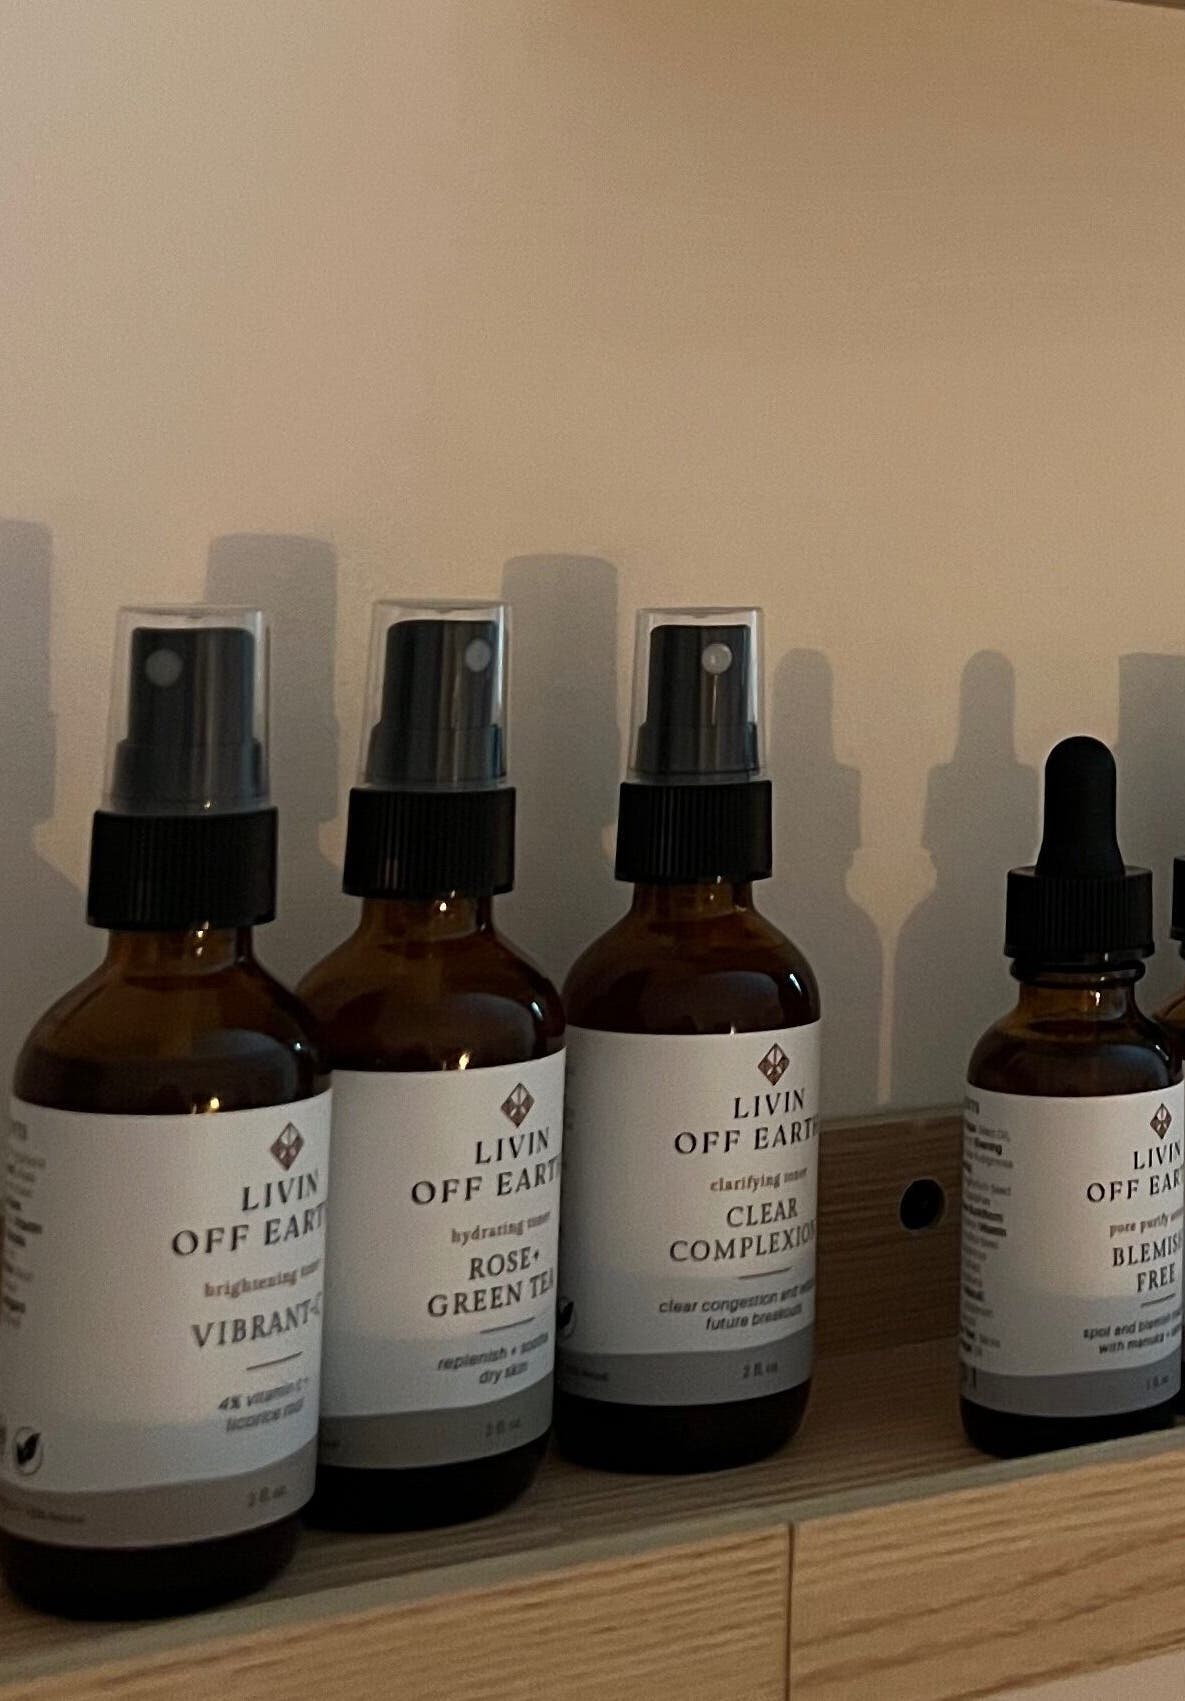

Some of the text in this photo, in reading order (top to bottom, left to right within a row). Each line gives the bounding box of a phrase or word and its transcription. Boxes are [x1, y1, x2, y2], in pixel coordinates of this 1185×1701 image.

[733, 1088, 805, 1119] LIVIN
[475, 1126, 550, 1165] LIVIN
[674, 1129, 741, 1154] OFF
[242, 1168, 319, 1212] LIVIN
[411, 1153, 562, 1205] OFF EART
[709, 1172, 782, 1192] clarifying
[1086, 1166, 1183, 1203] OFF EAR
[726, 1197, 799, 1229] CLEAR
[172, 1202, 325, 1256] OFF EART
[452, 1222, 524, 1246] hydrating
[204, 1269, 297, 1299] brightening
[1137, 1262, 1176, 1293] FREE
[427, 1278, 522, 1318] GREEN
[659, 1300, 698, 1314] clear
[701, 1292, 779, 1314] congestion
[705, 1314, 750, 1331] future
